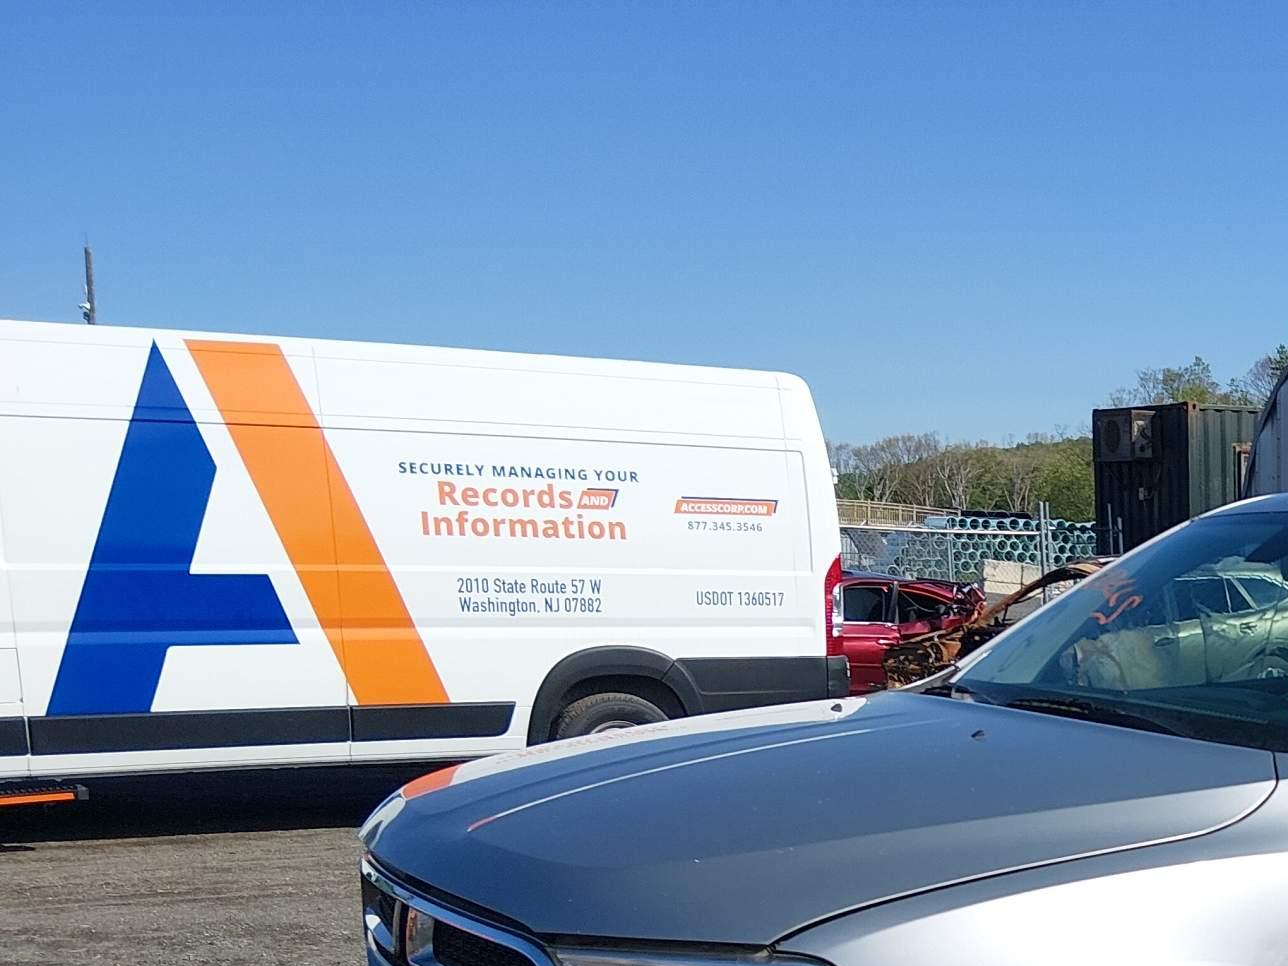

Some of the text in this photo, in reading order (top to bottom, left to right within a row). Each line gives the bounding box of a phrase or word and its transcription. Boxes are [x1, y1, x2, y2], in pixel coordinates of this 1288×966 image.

[398, 461, 640, 483] SECURELY MANAGING YOUR
[437, 480, 609, 509] Records AND
[420, 510, 628, 540] Information
[687, 521, 763, 532] 877.345.3546
[457, 578, 602, 595] 2010 State Route 57 W
[544, 598, 560, 613] NJ
[564, 598, 602, 613] 07882
[696, 591, 785, 607] USDOT 1360517
